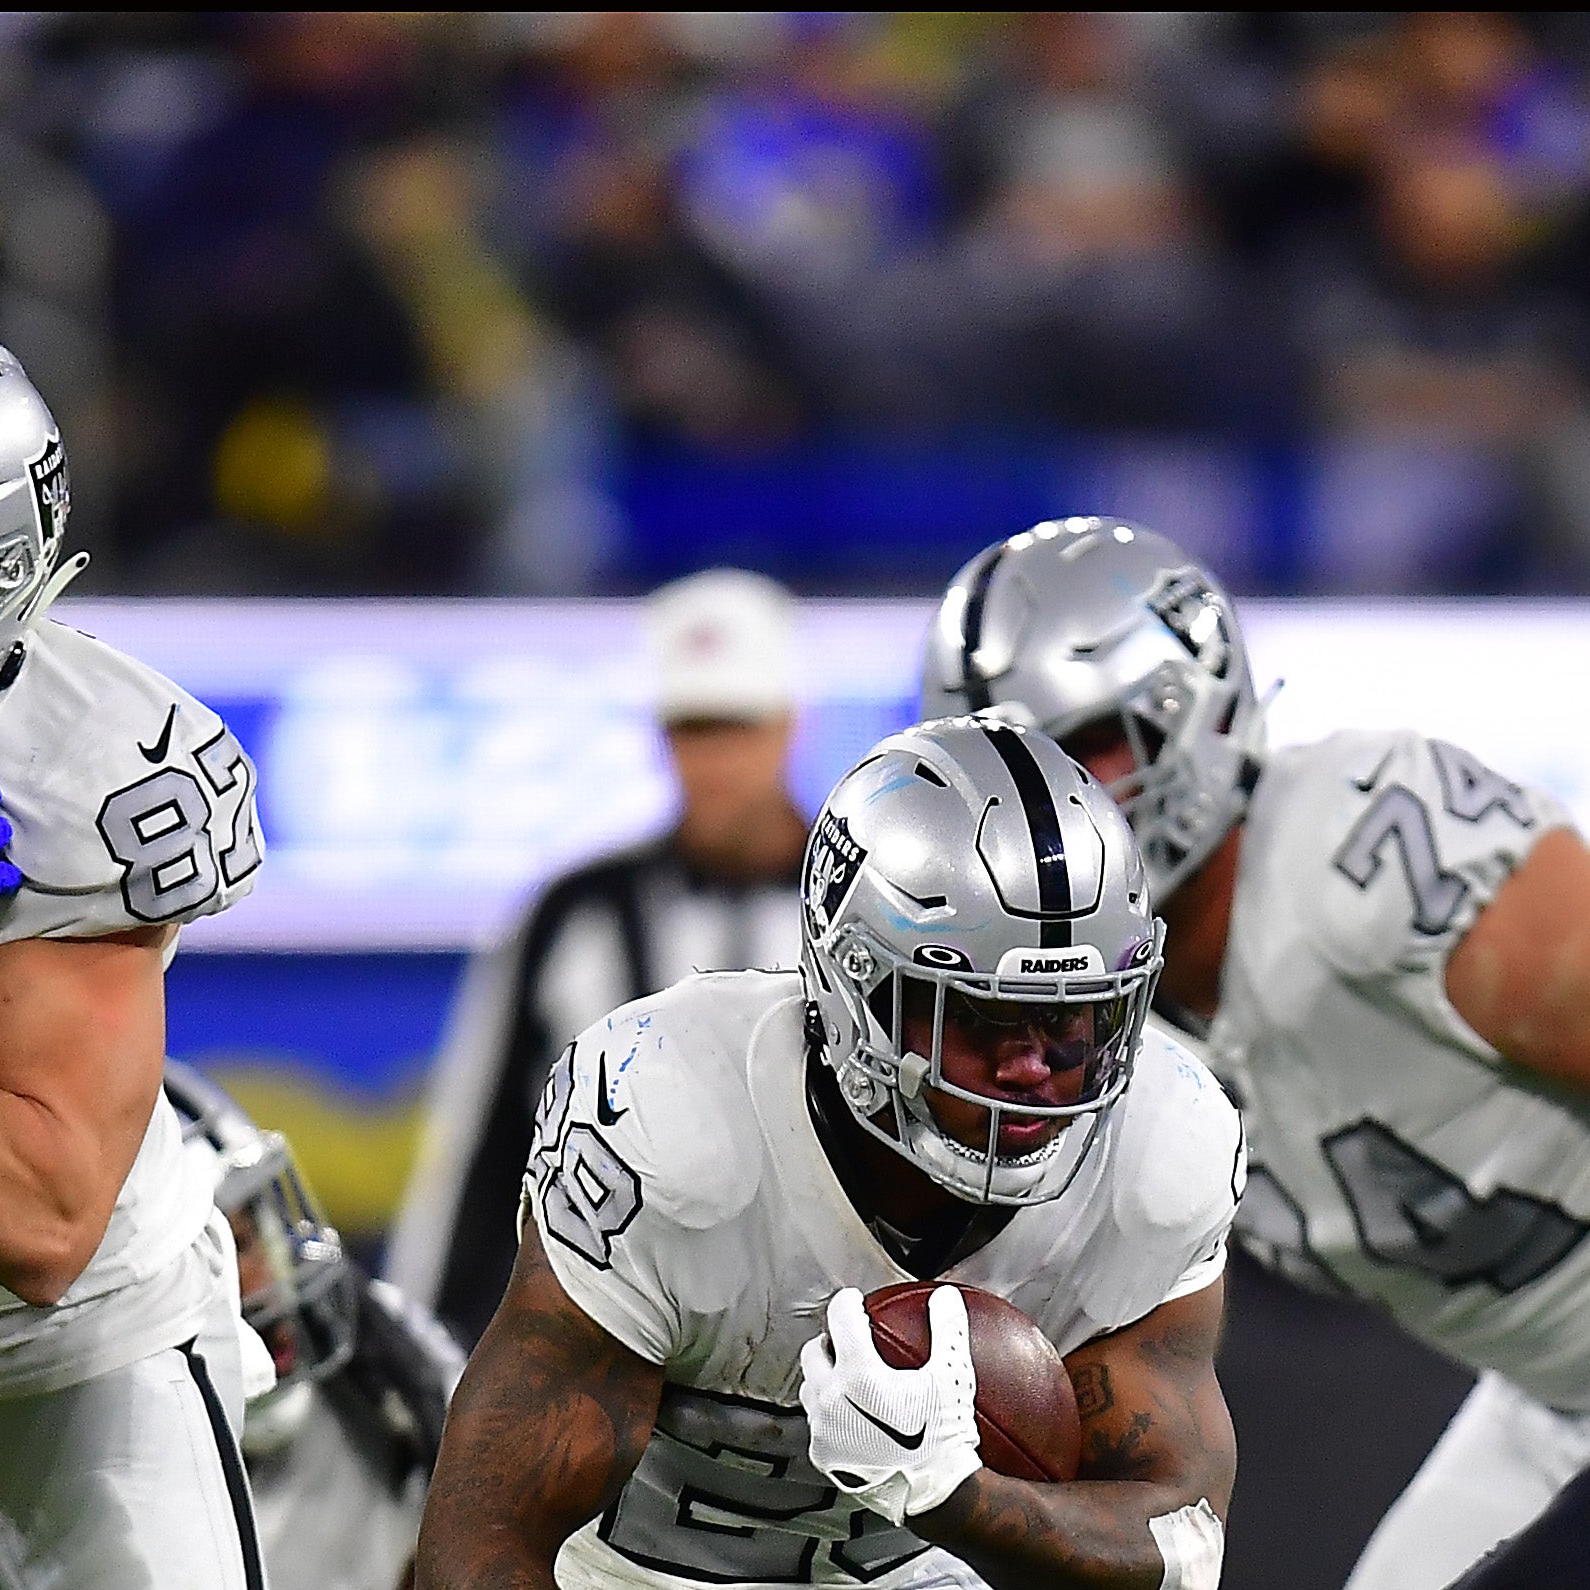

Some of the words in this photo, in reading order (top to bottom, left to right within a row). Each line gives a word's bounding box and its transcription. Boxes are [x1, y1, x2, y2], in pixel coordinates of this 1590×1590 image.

[95, 726, 262, 923] 87
[1333, 738, 1534, 935] 74
[1020, 956, 1089, 973] RAIDERS
